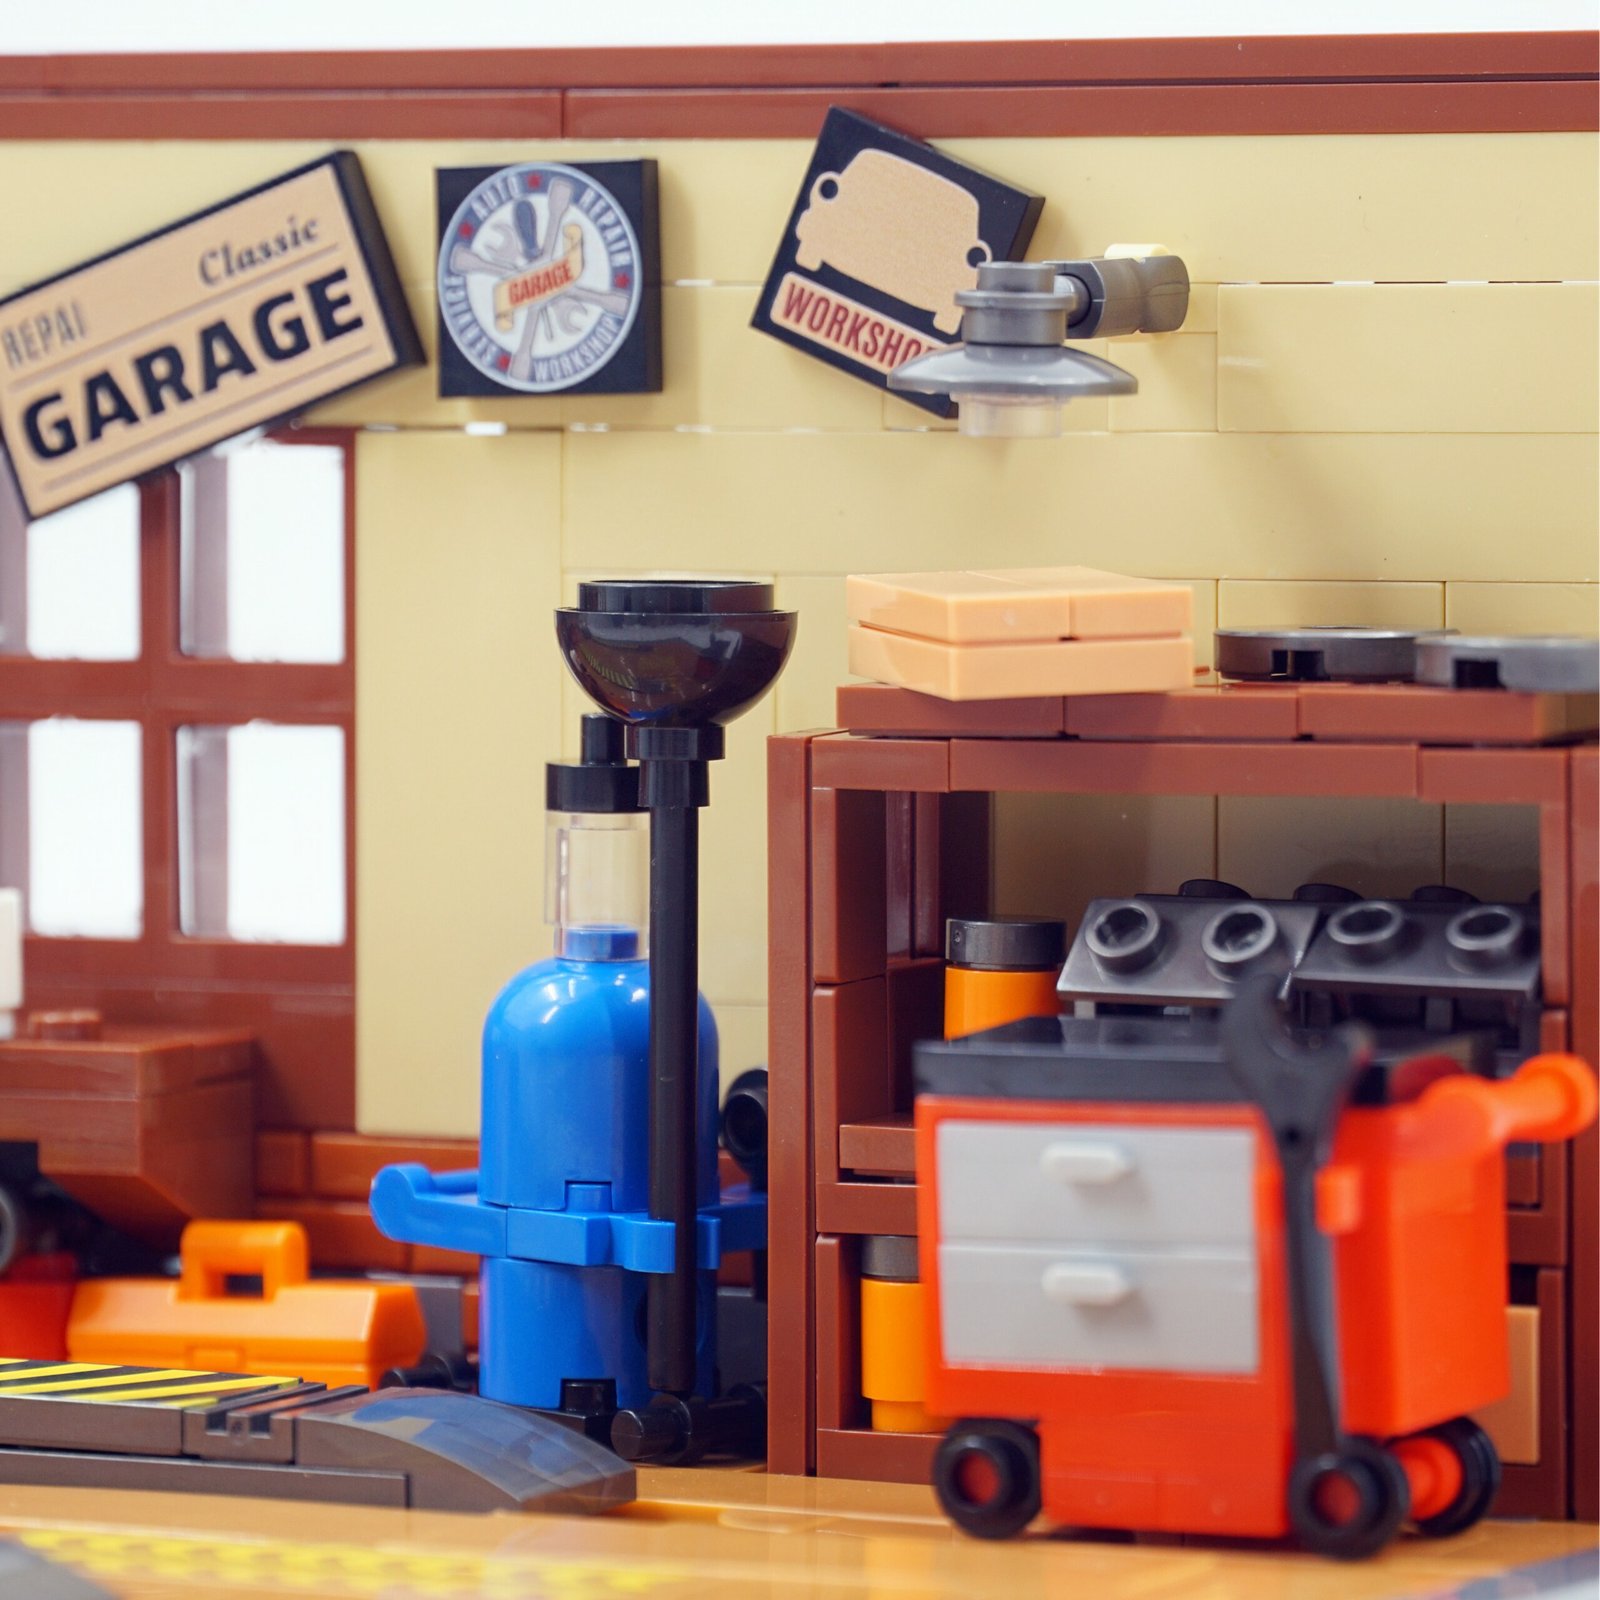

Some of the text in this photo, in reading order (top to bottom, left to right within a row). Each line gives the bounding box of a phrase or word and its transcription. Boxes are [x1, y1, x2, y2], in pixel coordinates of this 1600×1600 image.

[471, 174, 520, 220] AUTO
[578, 187, 632, 267] REPAIR
[199, 215, 320, 286] Classic
[508, 258, 573, 306] GARAGE
[533, 315, 620, 383] WORKSHOP
[782, 283, 937, 368] WORKSHO
[22, 267, 364, 460] GARAGE
